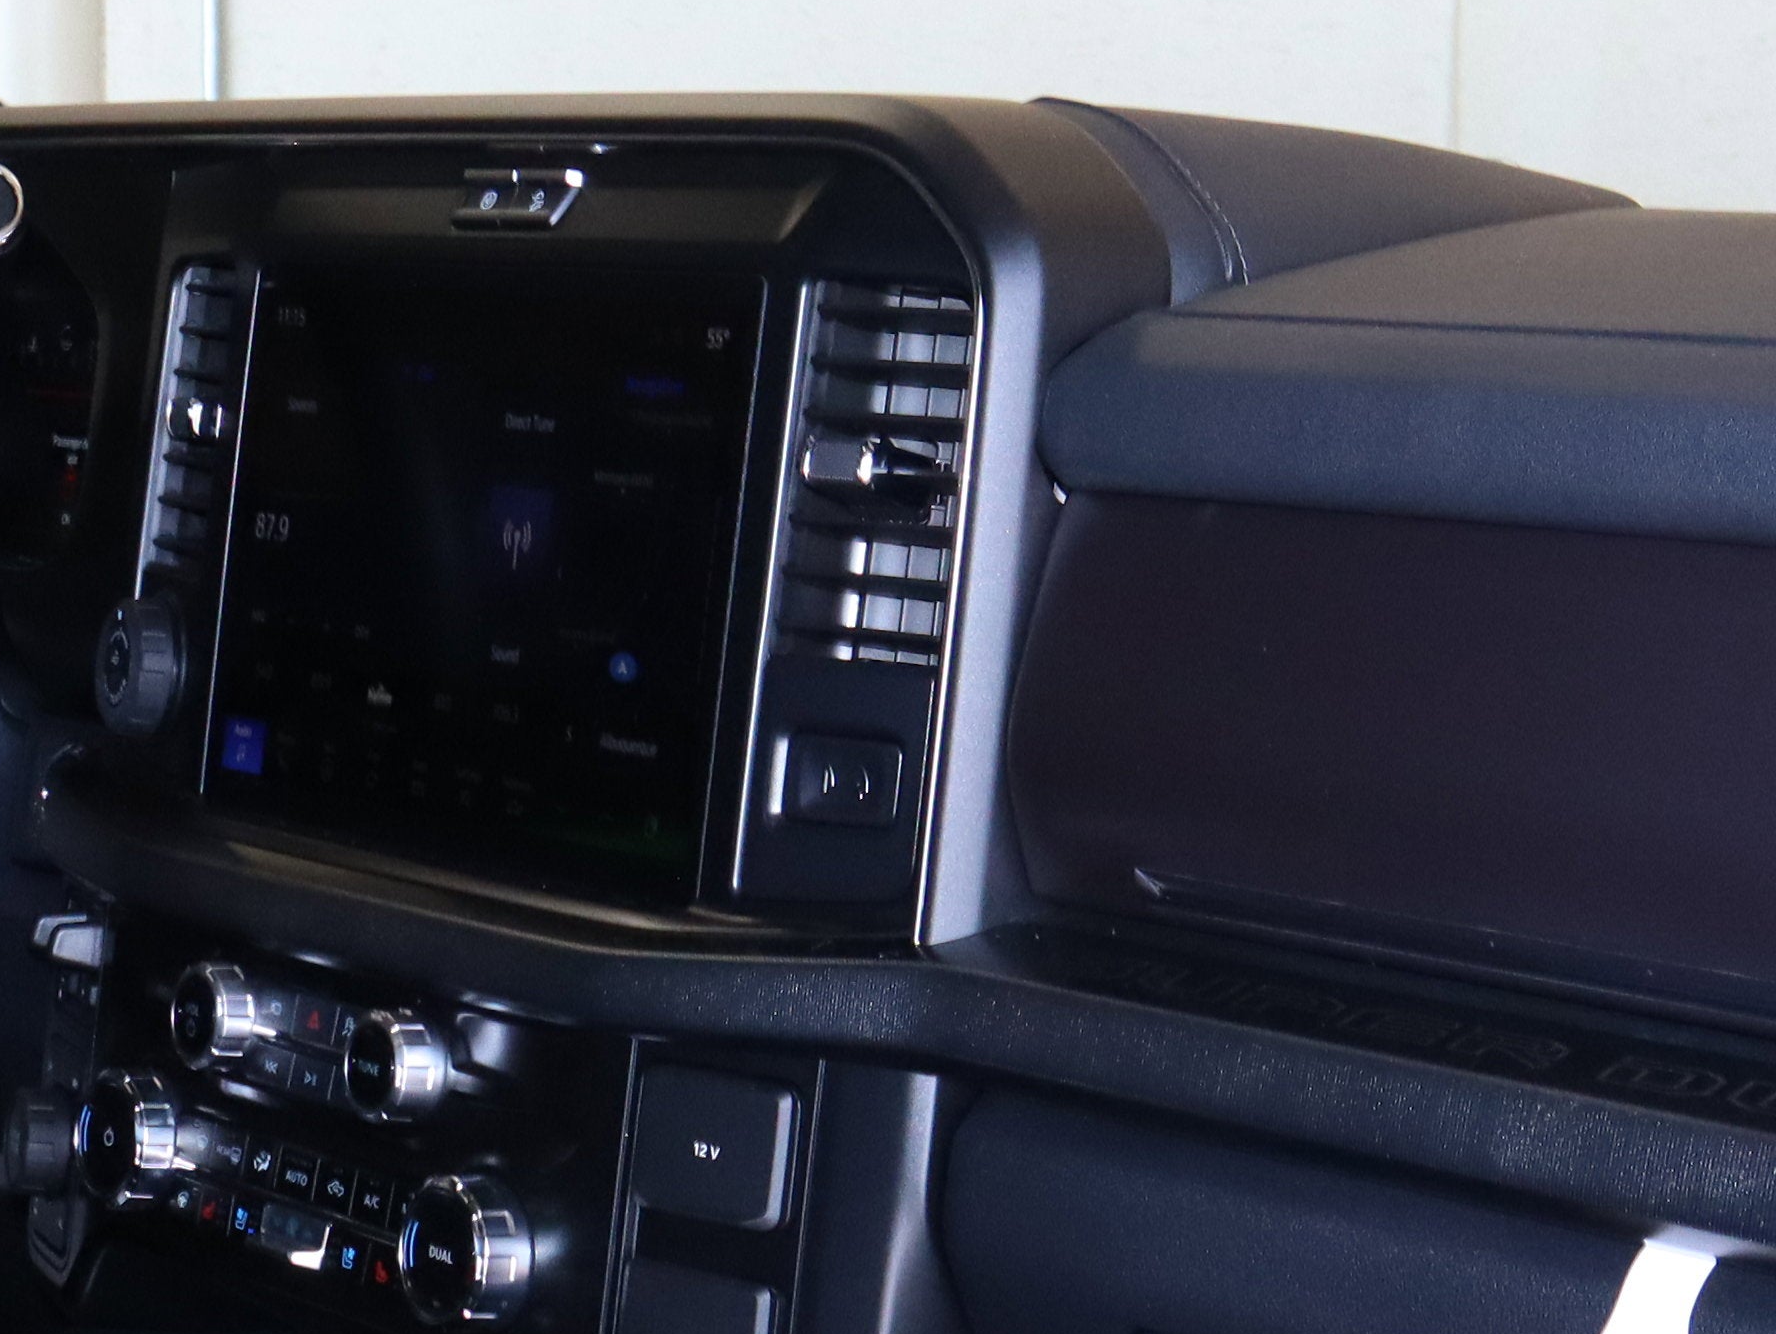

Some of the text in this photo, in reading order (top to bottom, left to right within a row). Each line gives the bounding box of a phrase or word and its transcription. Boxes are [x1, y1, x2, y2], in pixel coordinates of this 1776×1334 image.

[254, 510, 290, 542] 87.9
[284, 1168, 309, 1188] AUTO
[363, 1193, 382, 1210] A/C
[428, 1244, 454, 1265] DUAL
